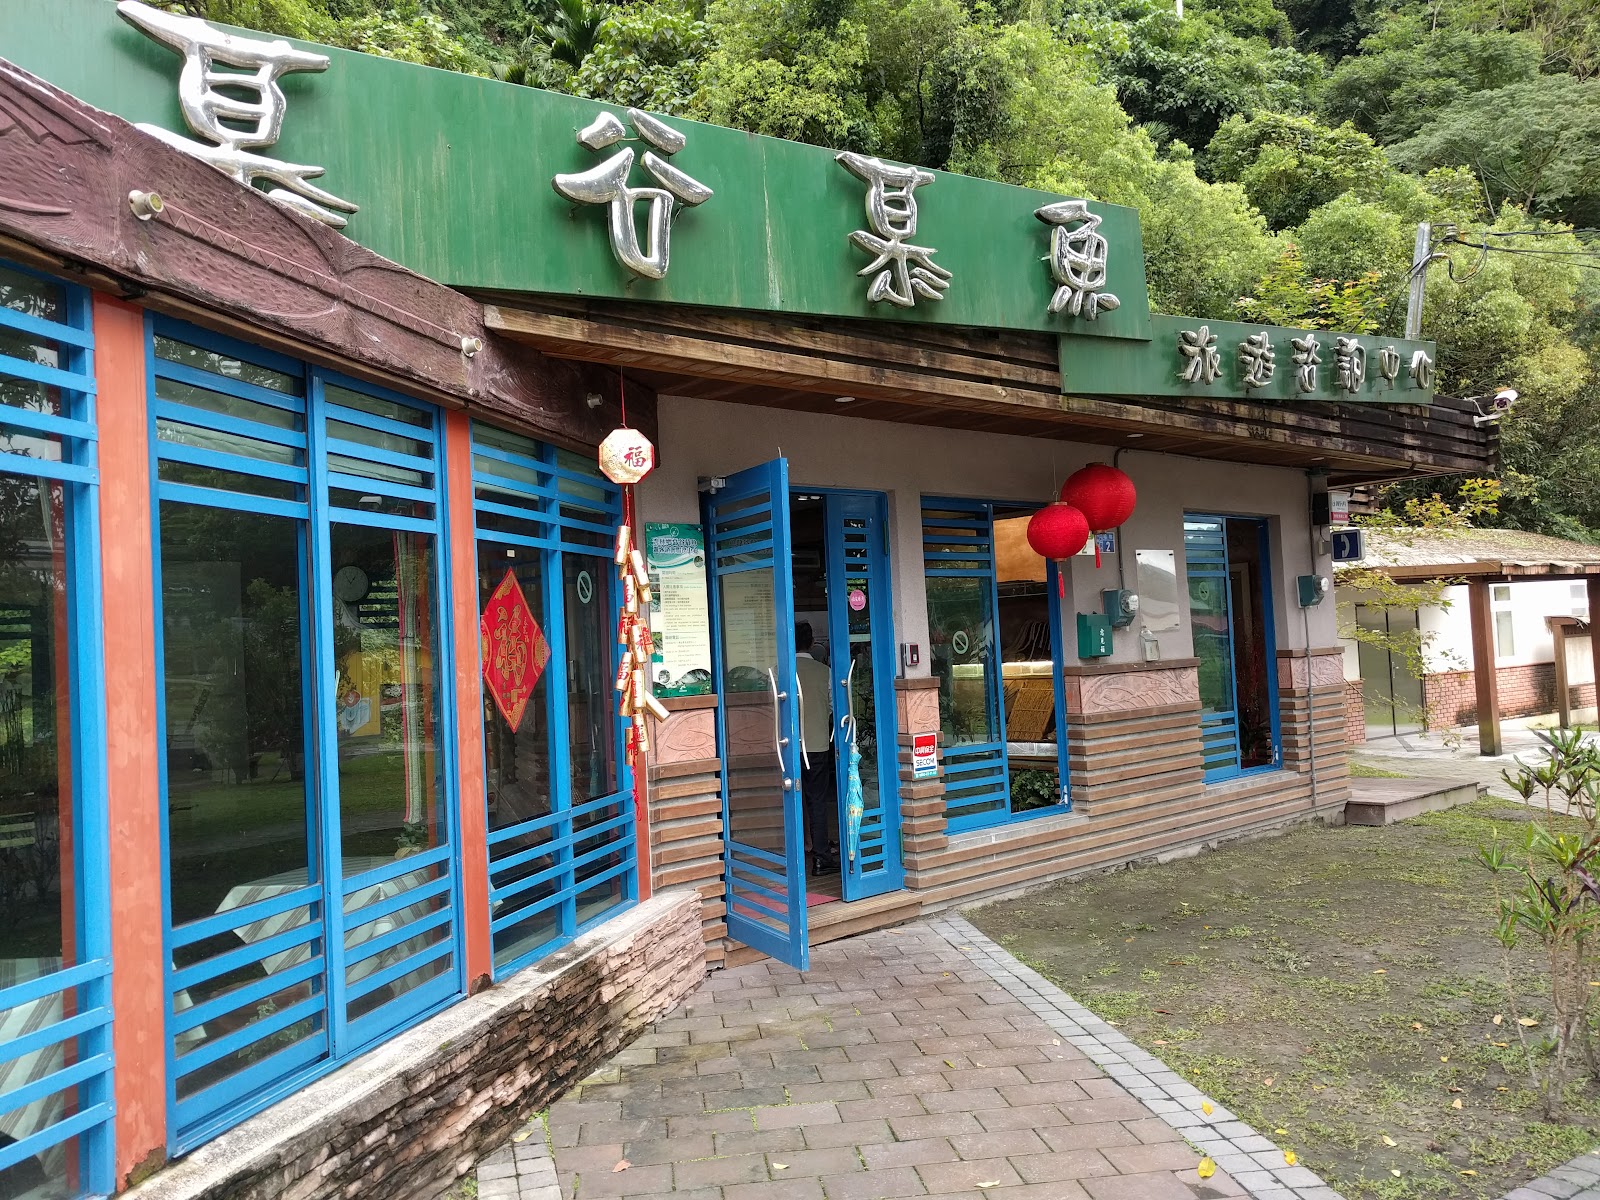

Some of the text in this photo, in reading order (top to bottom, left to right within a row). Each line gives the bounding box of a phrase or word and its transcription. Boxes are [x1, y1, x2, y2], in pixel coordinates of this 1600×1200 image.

[624, 446, 647, 468] 福
[1106, 541, 1111, 552] 2
[916, 757, 935, 767] SECOM
